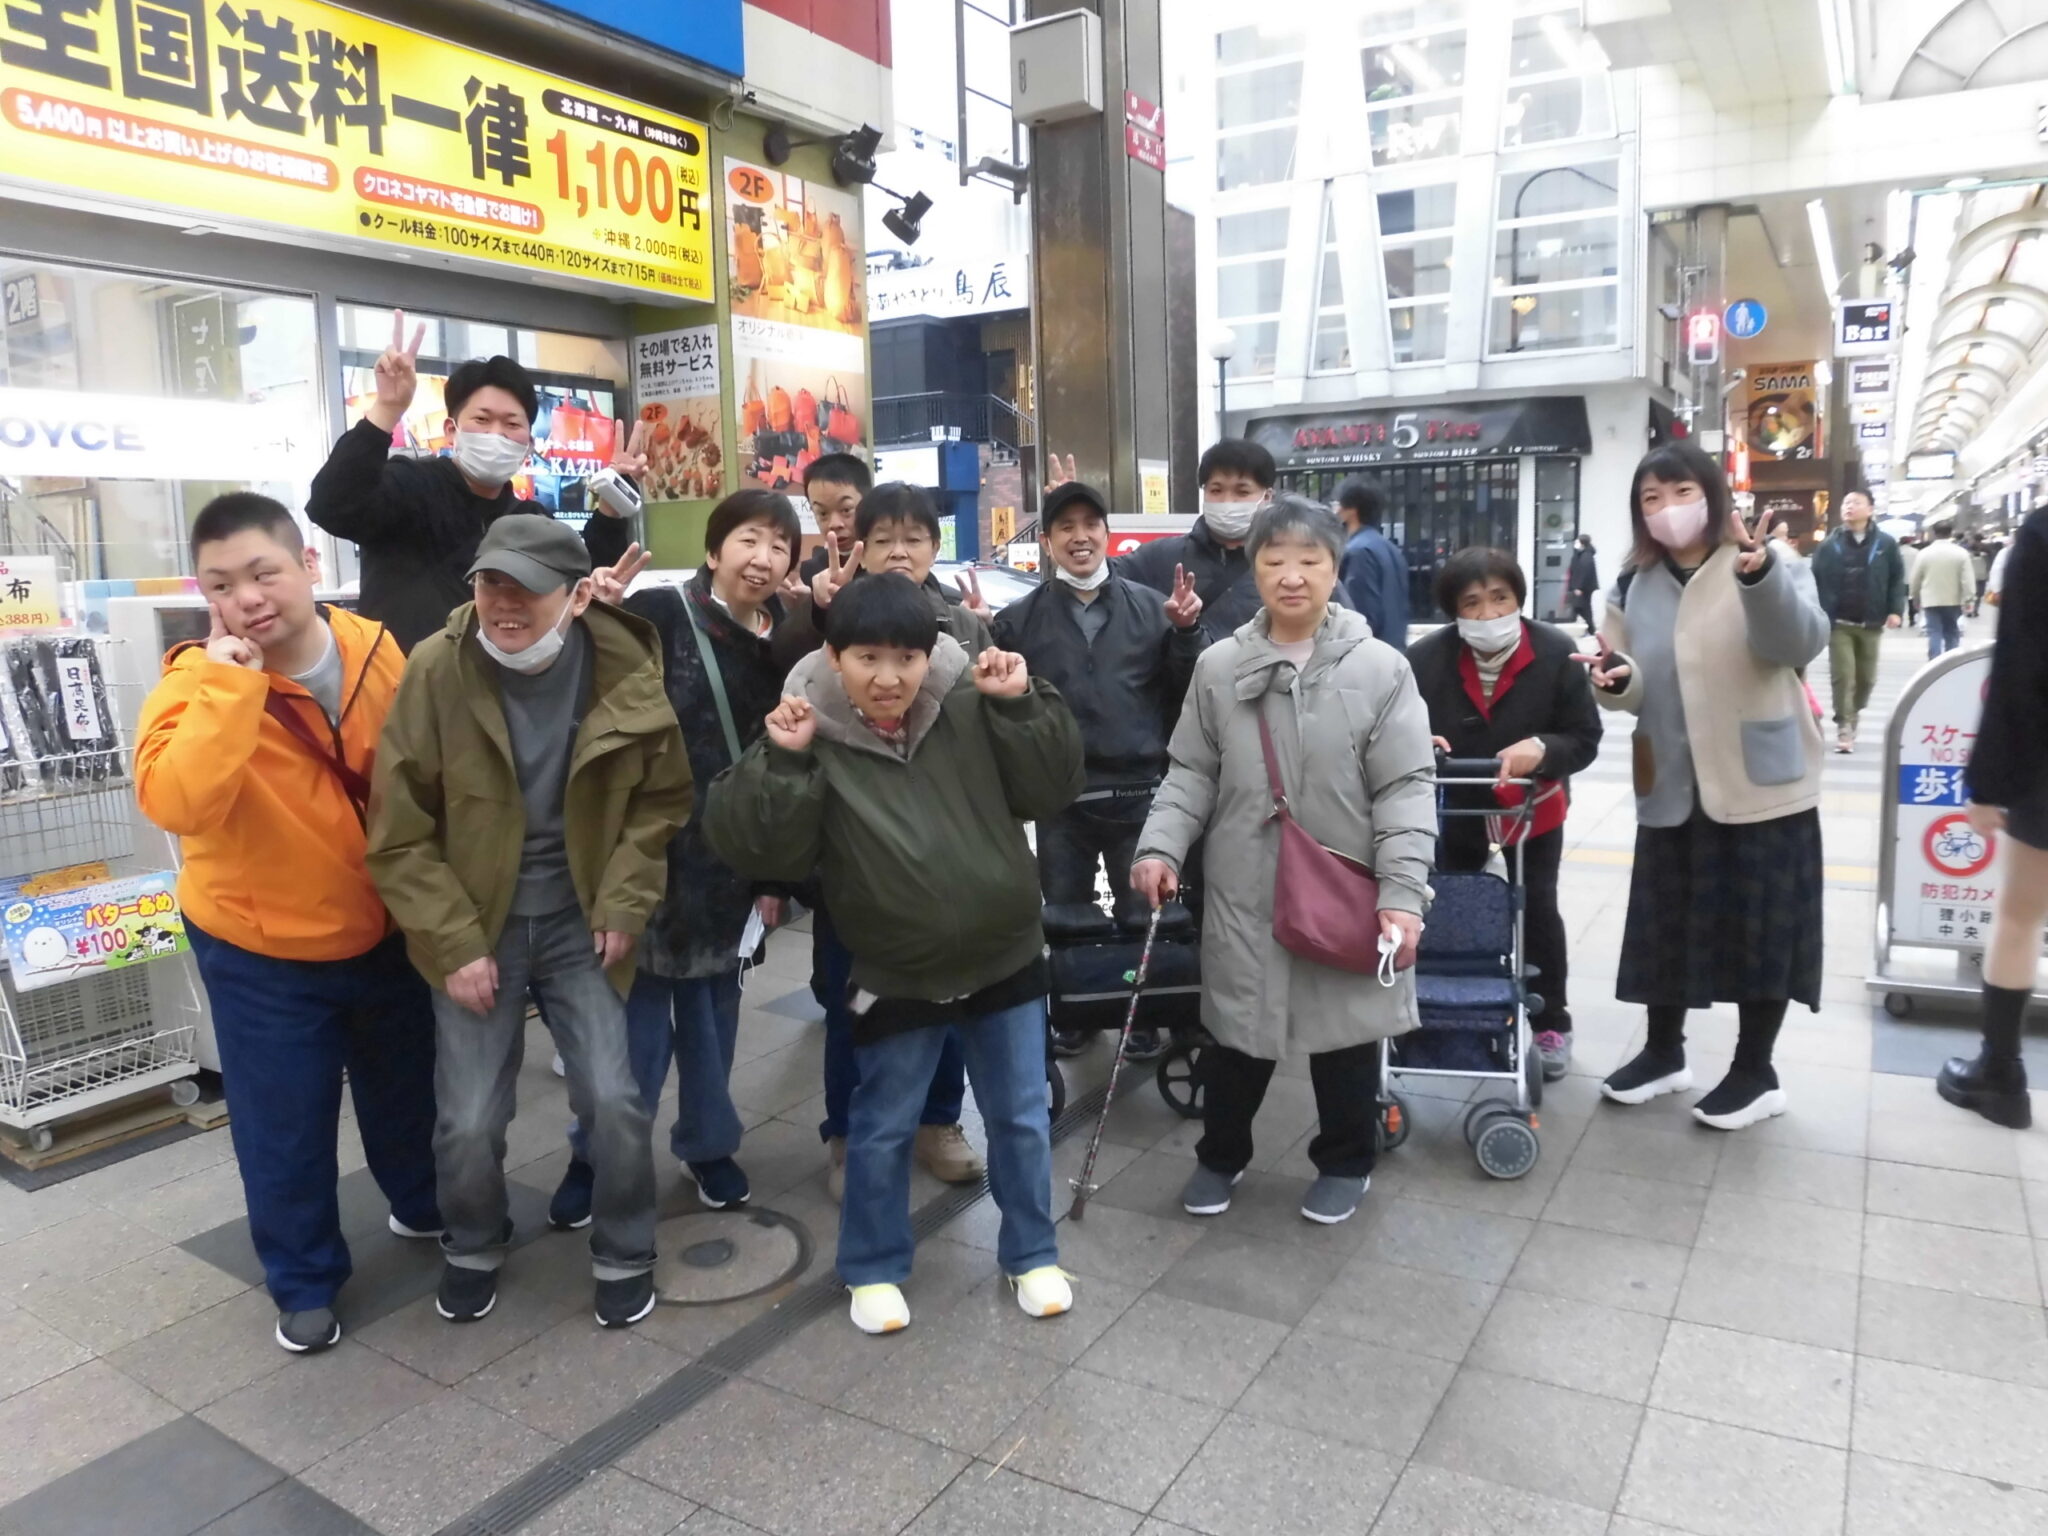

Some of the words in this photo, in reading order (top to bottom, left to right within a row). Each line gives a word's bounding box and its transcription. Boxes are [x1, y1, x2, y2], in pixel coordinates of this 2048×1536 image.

[0, 0, 531, 187] 全国送料一律
[739, 172, 765, 198] 2F
[1845, 324, 1889, 342] Bar
[640, 333, 713, 359] その場で名入れ
[640, 354, 714, 380] 無料サービス
[1754, 375, 1811, 391] SAMA
[646, 406, 662, 421] 2F
[1392, 412, 1420, 449] 5
[1343, 452, 1382, 463] WHISKY
[1796, 446, 1813, 459] 2F
[1930, 748, 1954, 763] NO
[1938, 924, 1979, 940] 中央
[75, 927, 128, 959] ¥100
